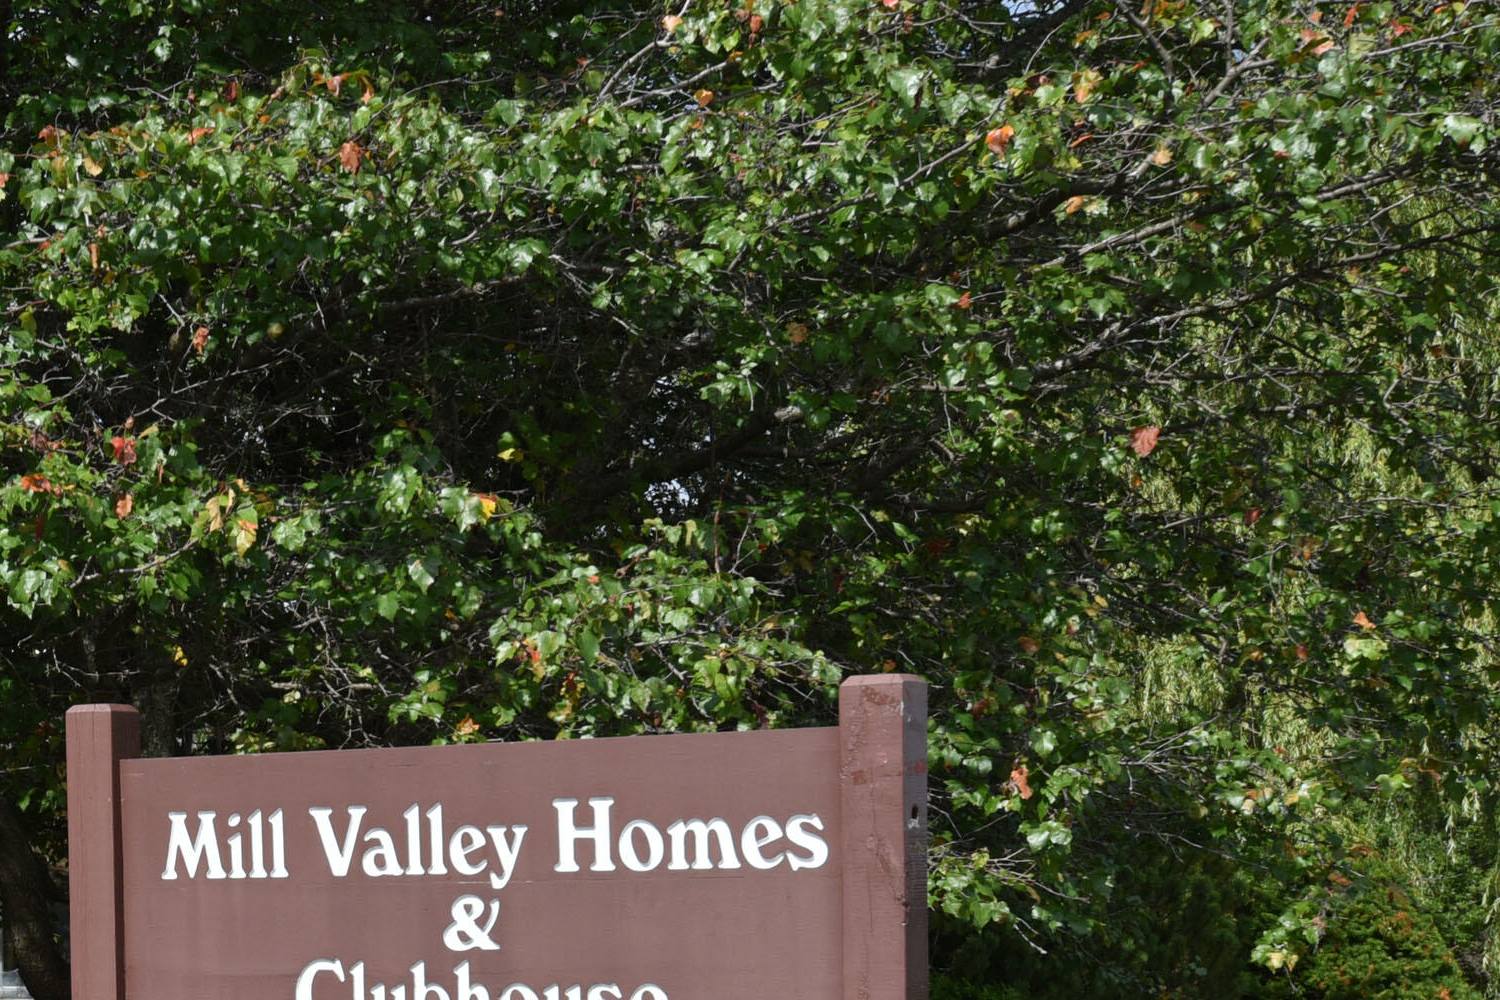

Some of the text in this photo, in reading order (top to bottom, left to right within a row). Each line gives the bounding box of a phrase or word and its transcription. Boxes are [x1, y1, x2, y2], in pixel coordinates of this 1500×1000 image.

[160, 797, 830, 890] Mill Valley Homes
[442, 894, 501, 952] &
